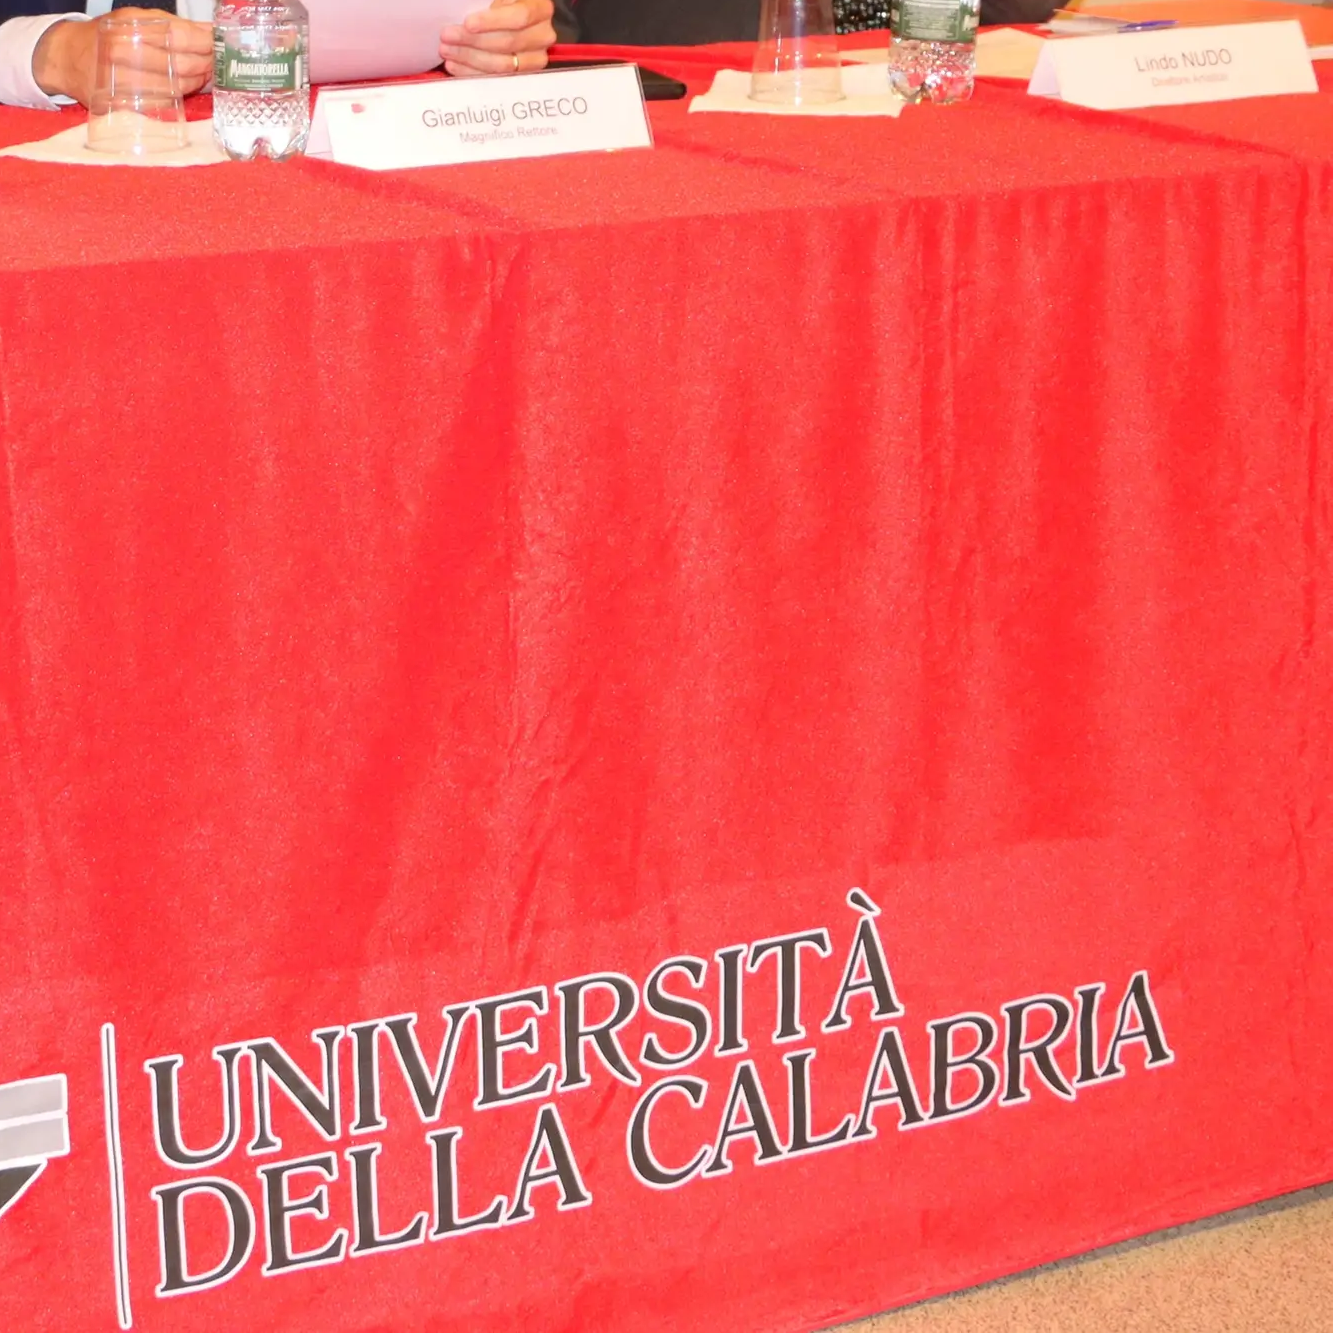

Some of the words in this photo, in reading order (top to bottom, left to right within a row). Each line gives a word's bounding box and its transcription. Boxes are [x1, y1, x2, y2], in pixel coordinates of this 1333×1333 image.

[1134, 54, 1178, 72] Lindo
[1181, 48, 1233, 67] NUDO
[422, 102, 506, 128] Gianluigi
[511, 96, 588, 121] GRECO
[459, 128, 514, 145] Magnifico
[517, 125, 558, 138] Rettore
[145, 888, 902, 1172] UNIVERSITÀ
[151, 1102, 593, 1298] DELLA
[624, 967, 1175, 1189] CALABRIA
